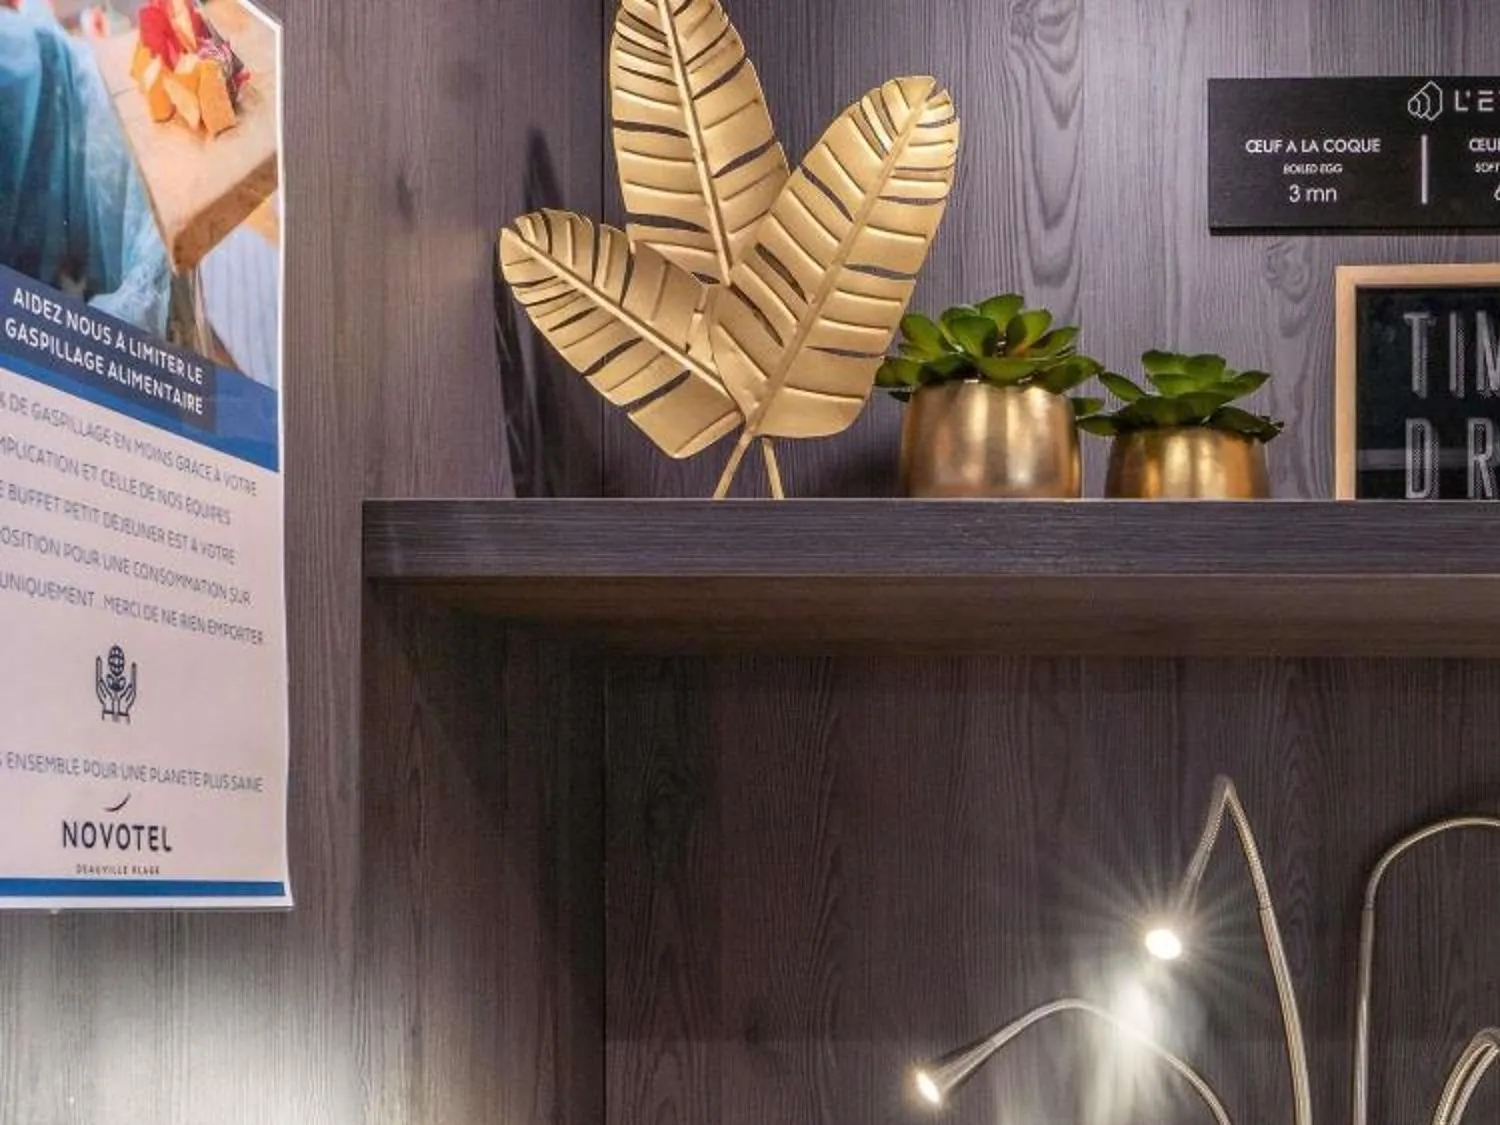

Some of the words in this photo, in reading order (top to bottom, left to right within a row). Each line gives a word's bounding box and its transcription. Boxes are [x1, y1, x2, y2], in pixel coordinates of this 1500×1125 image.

[1301, 139, 1319, 152] LA
[1323, 138, 1382, 153] COQUE
[1283, 163, 1319, 174] BOILED
[1320, 163, 1343, 174] EGG
[1474, 162, 1500, 173] SOFT
[1289, 183, 1301, 203] 3
[1305, 186, 1338, 203] mn
[13, 287, 63, 325] AIDEZ
[66, 309, 113, 346] NOUS
[115, 330, 127, 353] A
[129, 337, 185, 378] LIMITER
[187, 363, 203, 385] LE
[5, 317, 105, 375] GASPILLAGE
[108, 359, 203, 415] ALIMENTAIRE
[9, 392, 28, 416] DE
[31, 401, 112, 447] GASPILLAGE
[223, 470, 258, 497] VOTRE
[82, 462, 98, 482] ET
[100, 467, 138, 495] CELLE
[8, 483, 61, 512] BUFFET
[63, 542, 100, 566] POUR
[132, 560, 228, 600] CONSOMMATION
[207, 618, 264, 646] EMPORTER
[6, 751, 81, 777] ENSEMBLE
[83, 758, 118, 780] POUR
[120, 763, 148, 783] UNE
[62, 819, 173, 853] NOVOTEL
